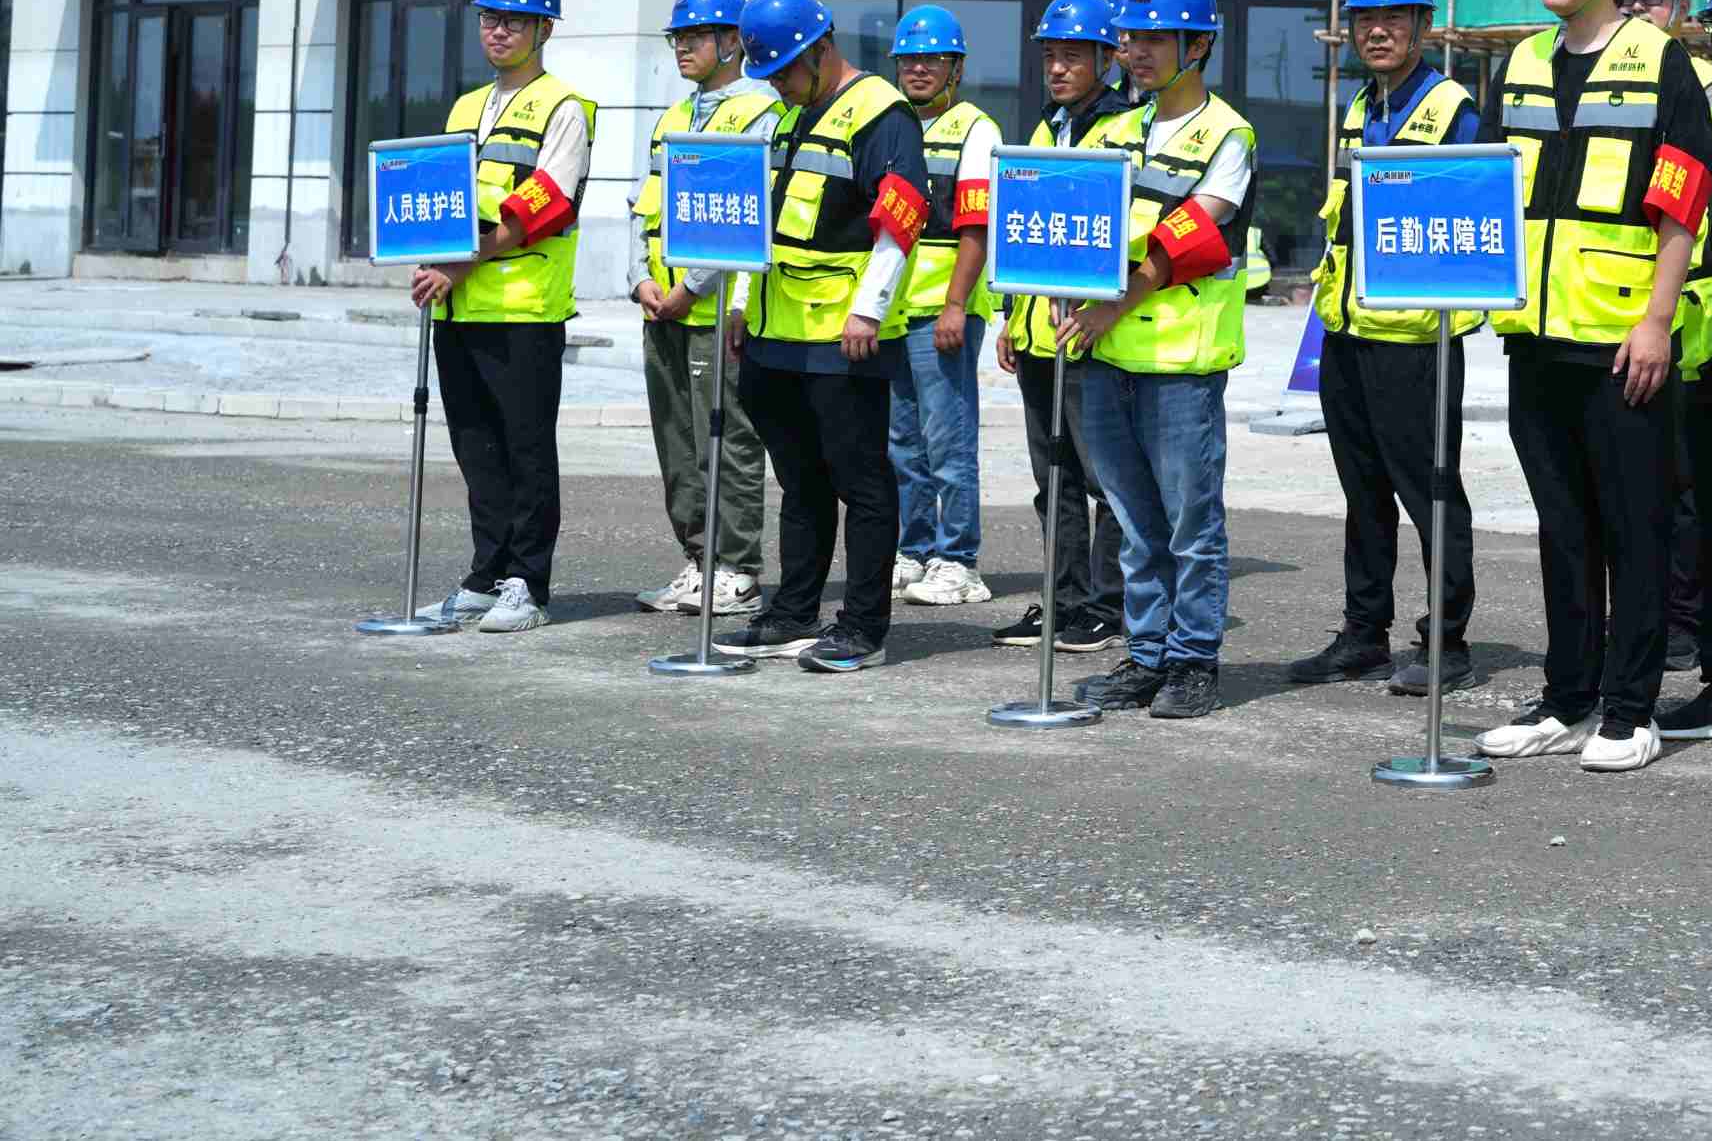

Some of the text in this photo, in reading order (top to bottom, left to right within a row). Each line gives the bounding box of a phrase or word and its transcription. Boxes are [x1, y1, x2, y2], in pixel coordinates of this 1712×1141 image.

[384, 190, 467, 224] 人员救护组
[676, 191, 760, 225] 通讯联络组
[960, 188, 989, 215] 人员救
[1005, 210, 1113, 249] 安全保卫组
[1161, 206, 1200, 240] 卫组
[1376, 216, 1505, 255] 后勤保障组
